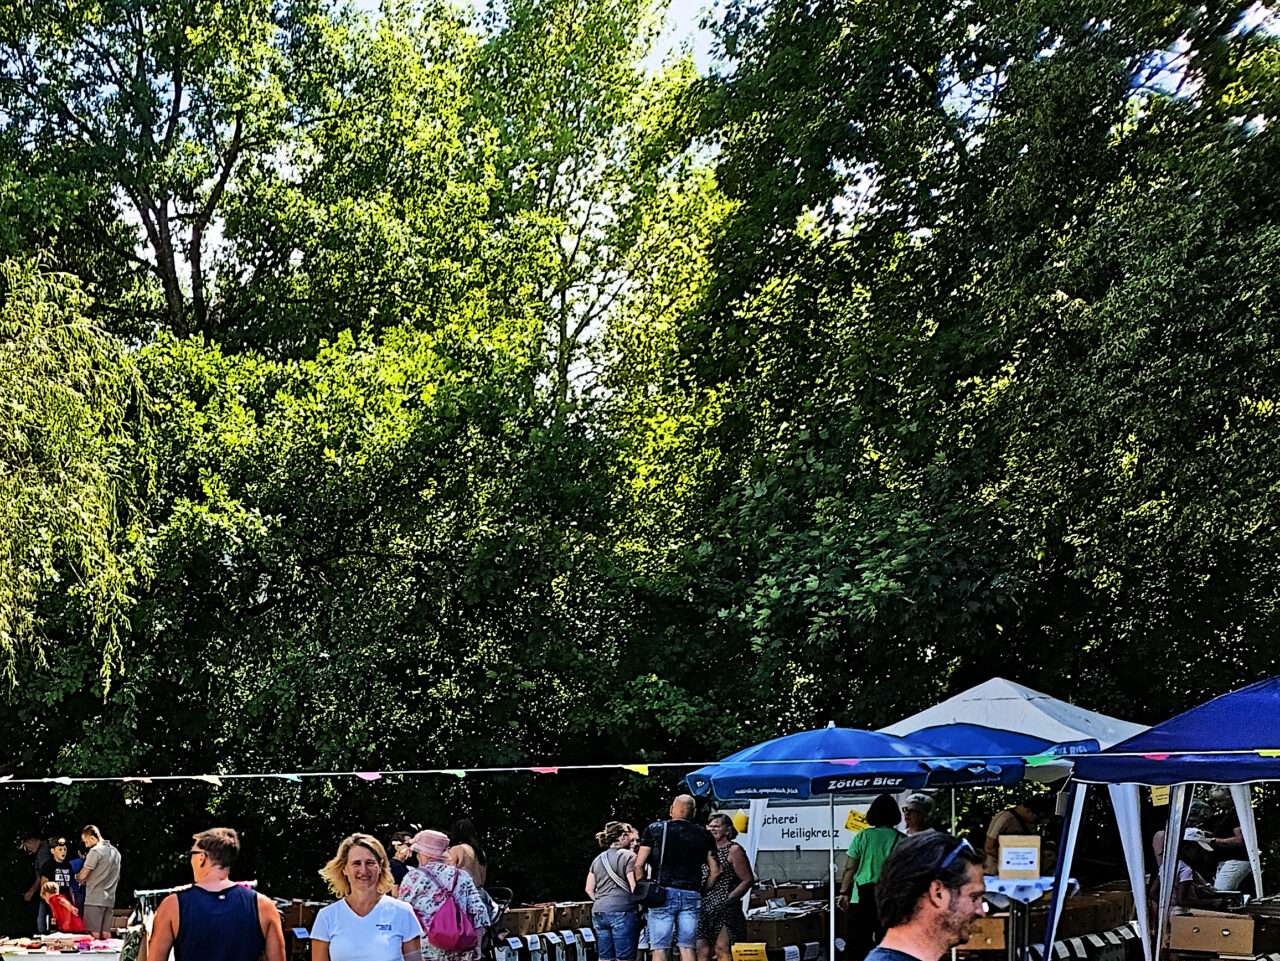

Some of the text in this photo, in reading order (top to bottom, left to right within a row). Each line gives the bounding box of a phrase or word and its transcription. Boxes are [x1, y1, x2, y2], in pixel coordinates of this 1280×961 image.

[827, 777, 903, 790] Zötler Bier
[762, 813, 798, 827] cherei
